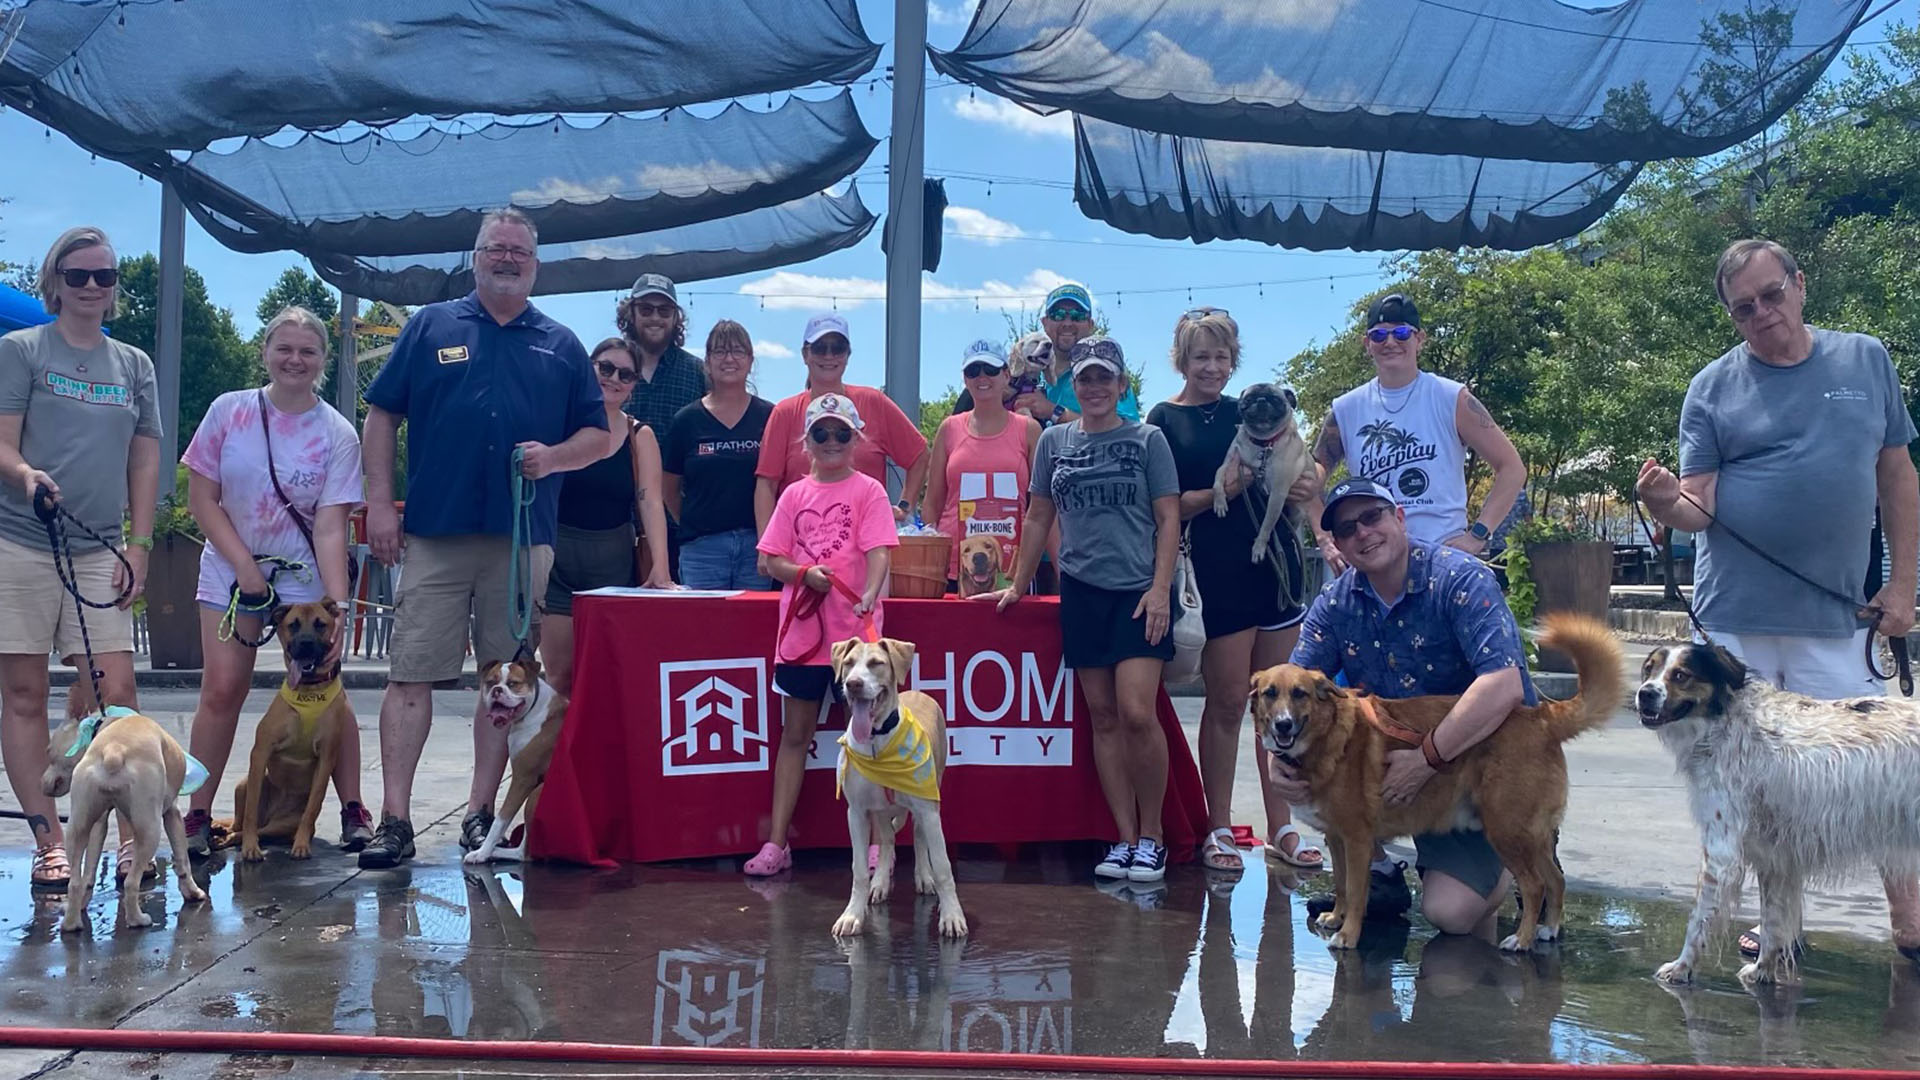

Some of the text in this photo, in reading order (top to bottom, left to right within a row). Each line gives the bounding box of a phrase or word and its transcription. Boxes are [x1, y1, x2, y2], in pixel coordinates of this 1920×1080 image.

[47, 373, 89, 392] DRINK
[1360, 443, 1438, 477] Everplay
[969, 522, 1013, 534] MILK-BONE
[807, 735, 1054, 760] RLTY
